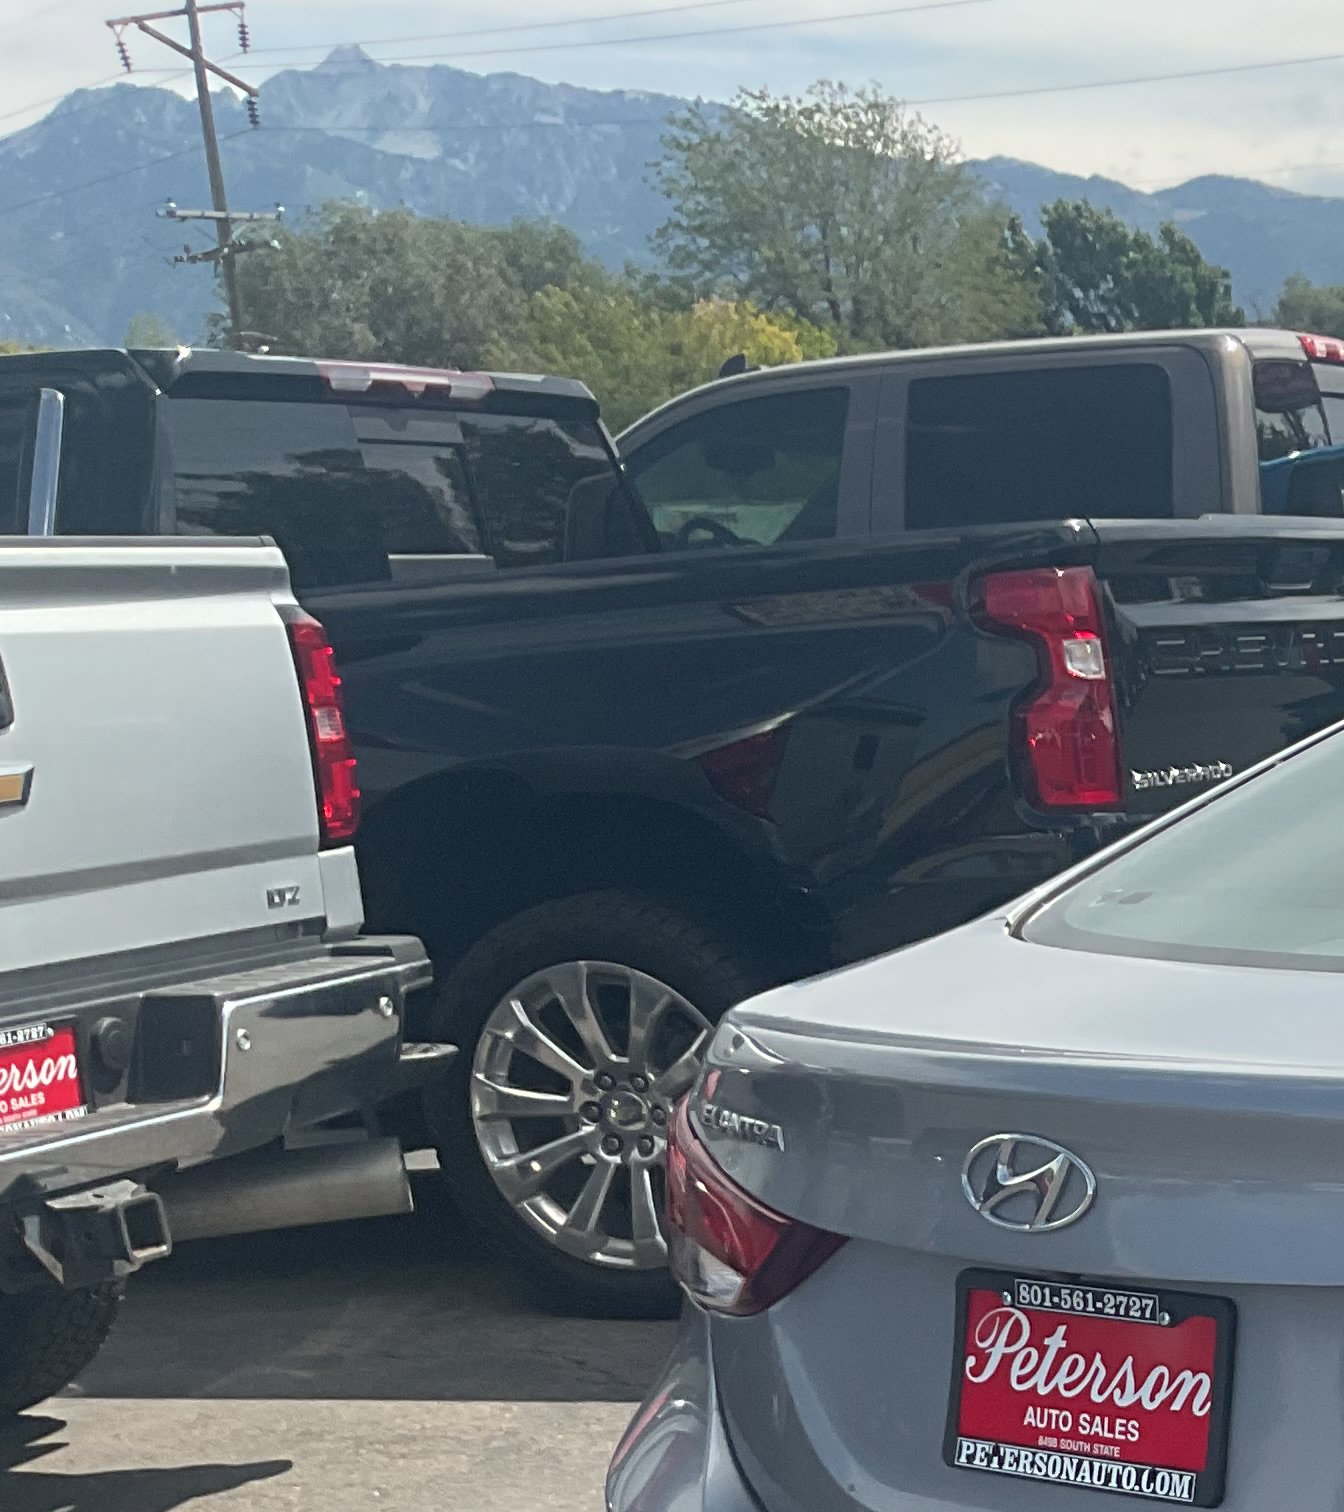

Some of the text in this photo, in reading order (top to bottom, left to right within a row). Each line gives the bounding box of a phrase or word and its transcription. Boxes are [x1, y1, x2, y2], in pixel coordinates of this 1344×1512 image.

[1131, 761, 1233, 789] SILVERADO
[10, 1091, 46, 1111] SALES
[1019, 1283, 1154, 1319] 801-561-2727
[965, 1307, 1212, 1417] Peterson
[1023, 1405, 1140, 1442] AUTO SALES
[1059, 1438, 1091, 1453] SOUTH
[1093, 1443, 1121, 1458] STATE
[958, 1440, 1192, 1499] PETERSONAUTO.COM
